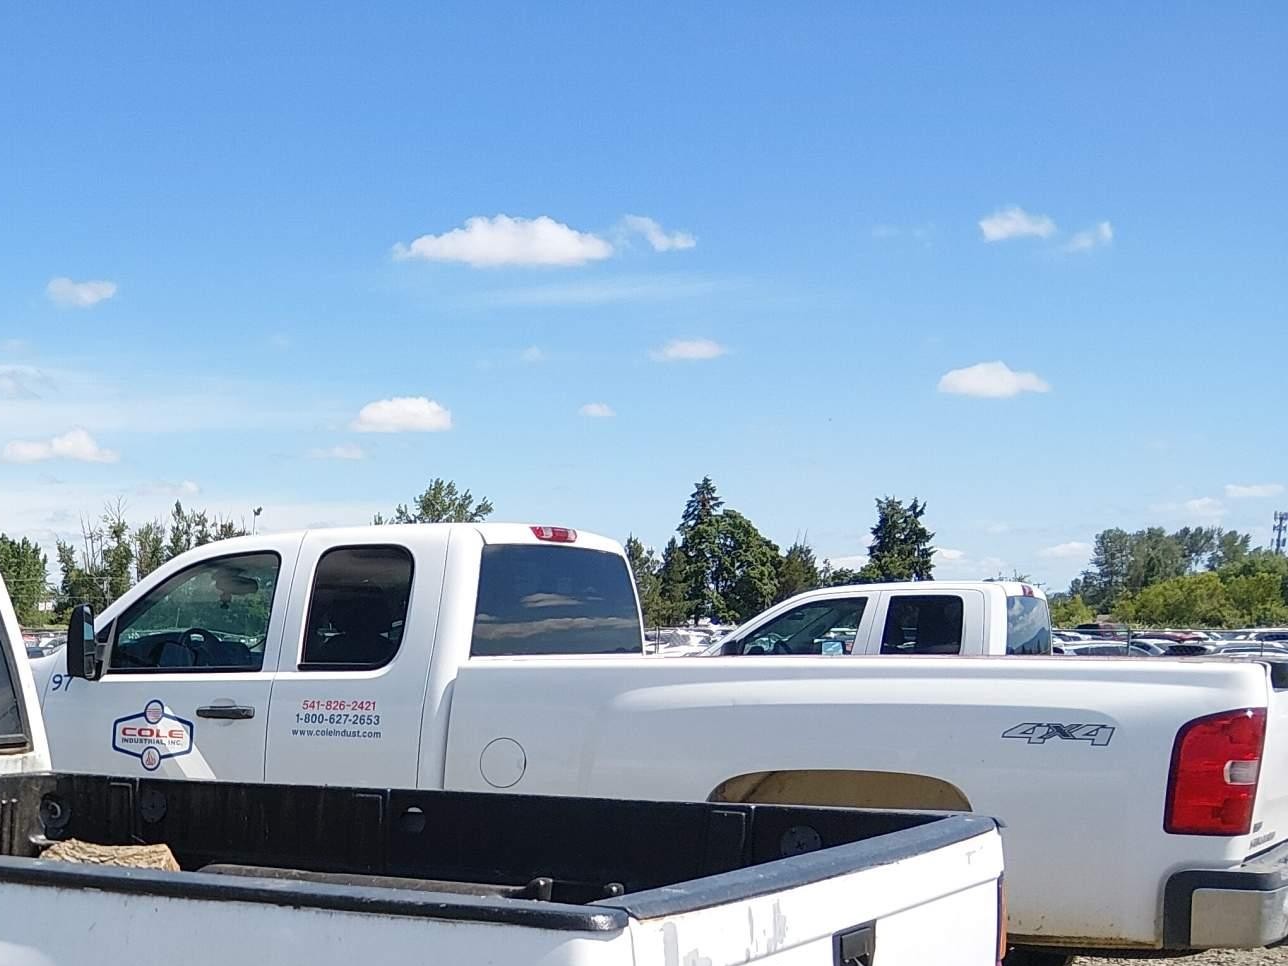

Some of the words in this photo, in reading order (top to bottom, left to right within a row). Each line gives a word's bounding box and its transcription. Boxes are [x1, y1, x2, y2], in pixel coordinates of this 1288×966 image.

[302, 699, 377, 711] 541-826-2421
[295, 712, 381, 726] 1-800-627-2653
[121, 727, 184, 739] COLE
